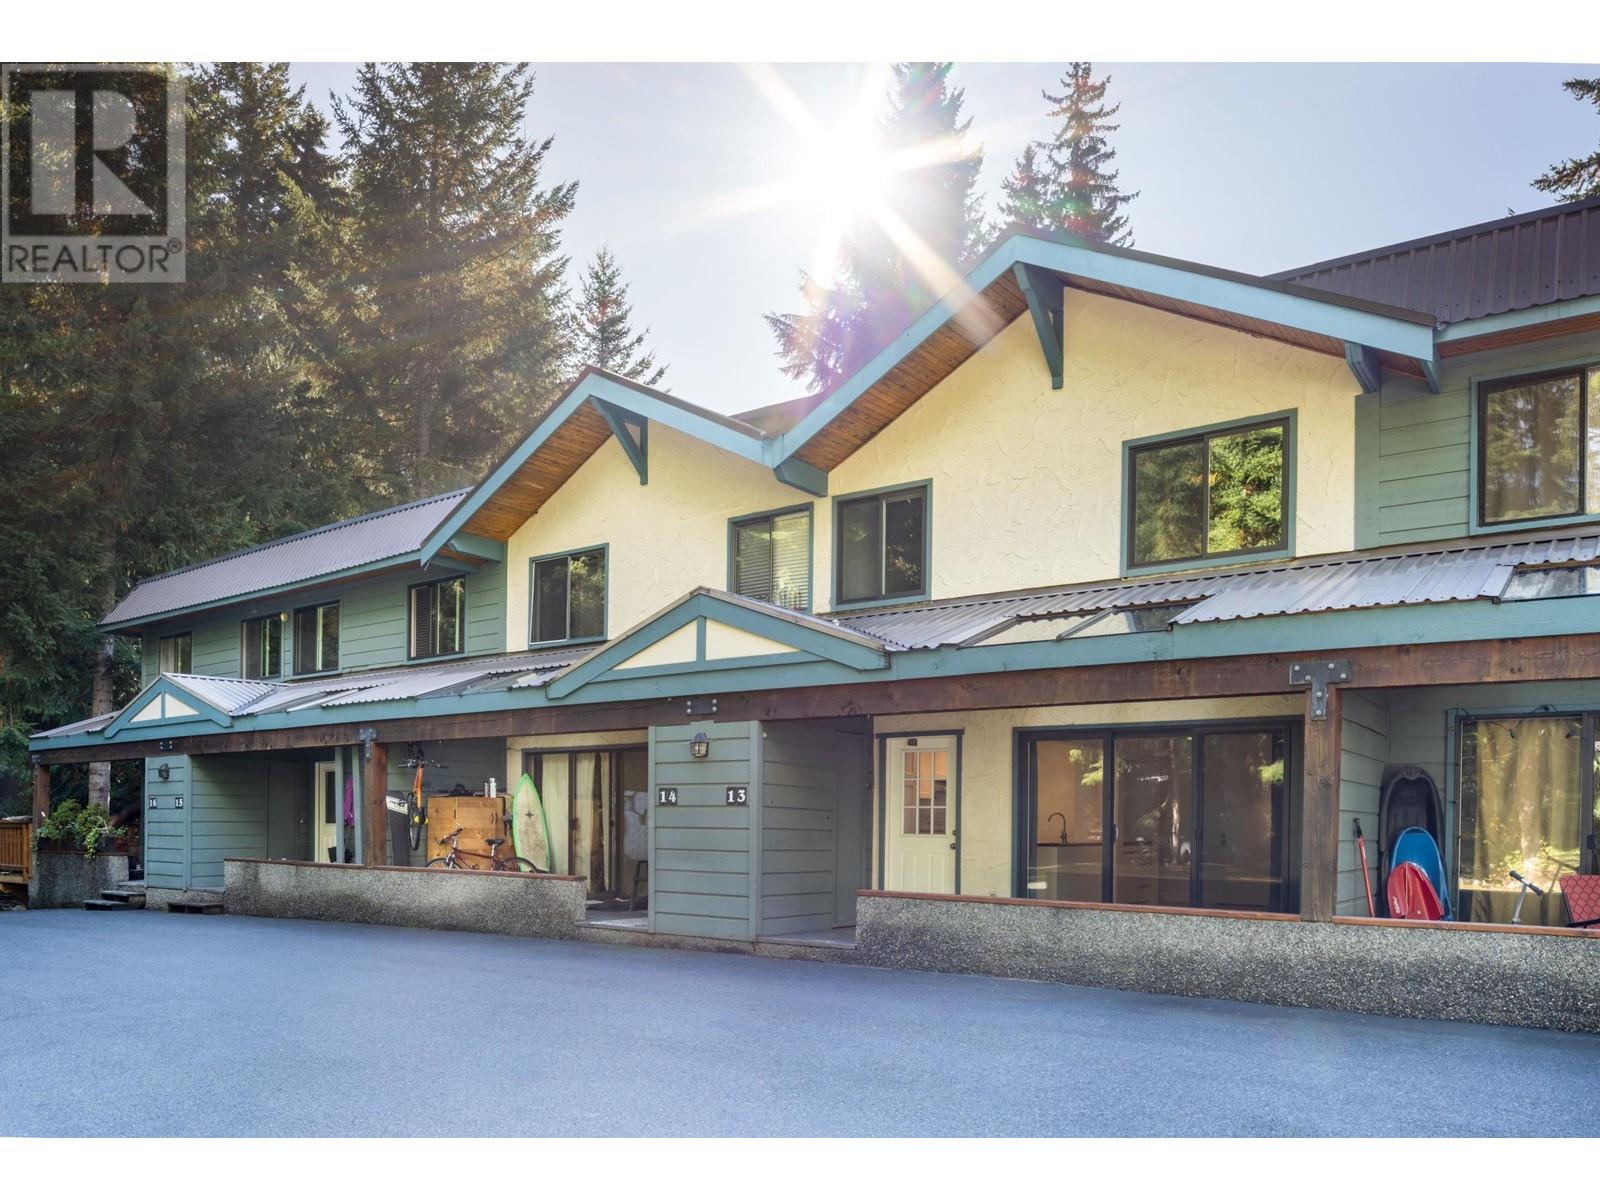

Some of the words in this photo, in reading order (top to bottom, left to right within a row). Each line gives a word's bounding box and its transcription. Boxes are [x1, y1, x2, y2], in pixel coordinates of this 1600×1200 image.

[659, 790, 677, 803] 14
[727, 789, 746, 803] 13
[149, 799, 157, 807] 16
[175, 798, 183, 807] 15
